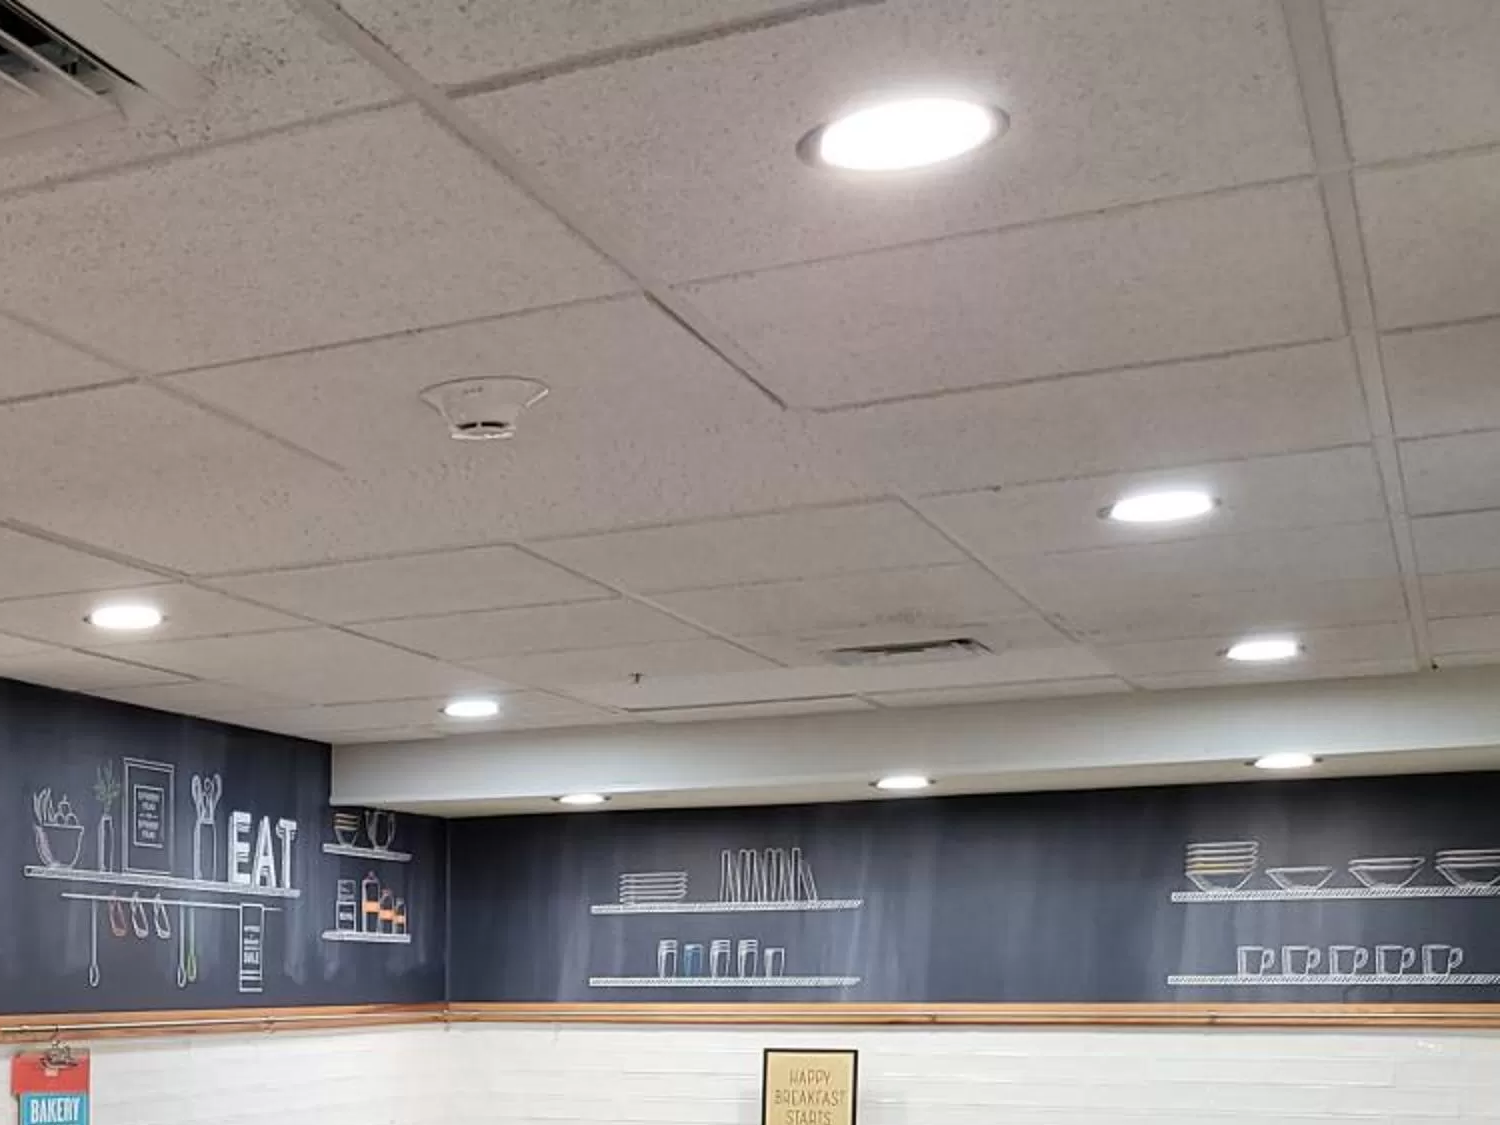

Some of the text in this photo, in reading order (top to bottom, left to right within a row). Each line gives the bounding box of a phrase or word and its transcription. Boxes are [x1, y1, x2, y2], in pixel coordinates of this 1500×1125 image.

[228, 811, 297, 889] EAT
[789, 1069, 832, 1086] HAPPY
[773, 1089, 847, 1107] BREAKFAST
[30, 1097, 81, 1123] BAKERY
